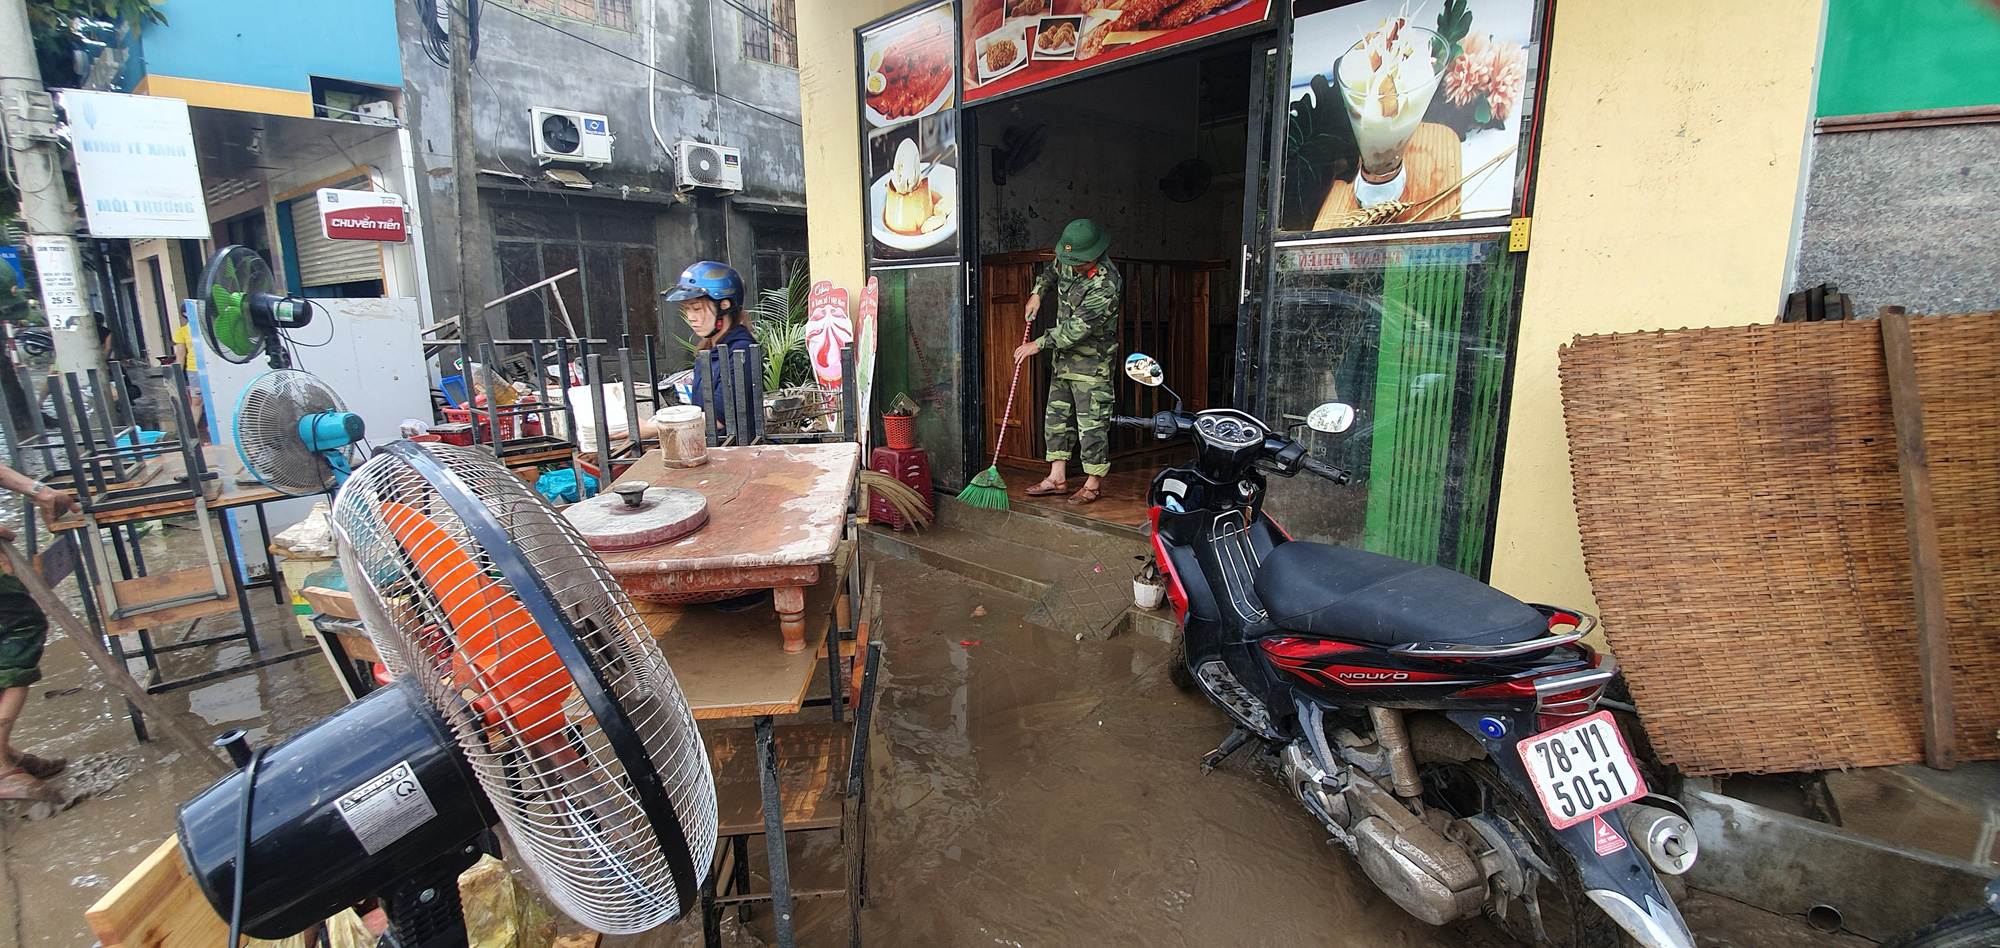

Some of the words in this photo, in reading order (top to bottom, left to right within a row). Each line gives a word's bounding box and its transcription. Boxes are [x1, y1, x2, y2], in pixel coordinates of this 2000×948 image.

[83, 140, 121, 153] KINH
[147, 142, 187, 157] XANH
[97, 197, 128, 212] MÔI
[331, 214, 376, 229] CHUYỂN
[53, 315, 62, 326] 3
[1339, 672, 1409, 680] NOUVO
[1534, 723, 1610, 779] 78-V1
[1552, 761, 1628, 817] 5051
